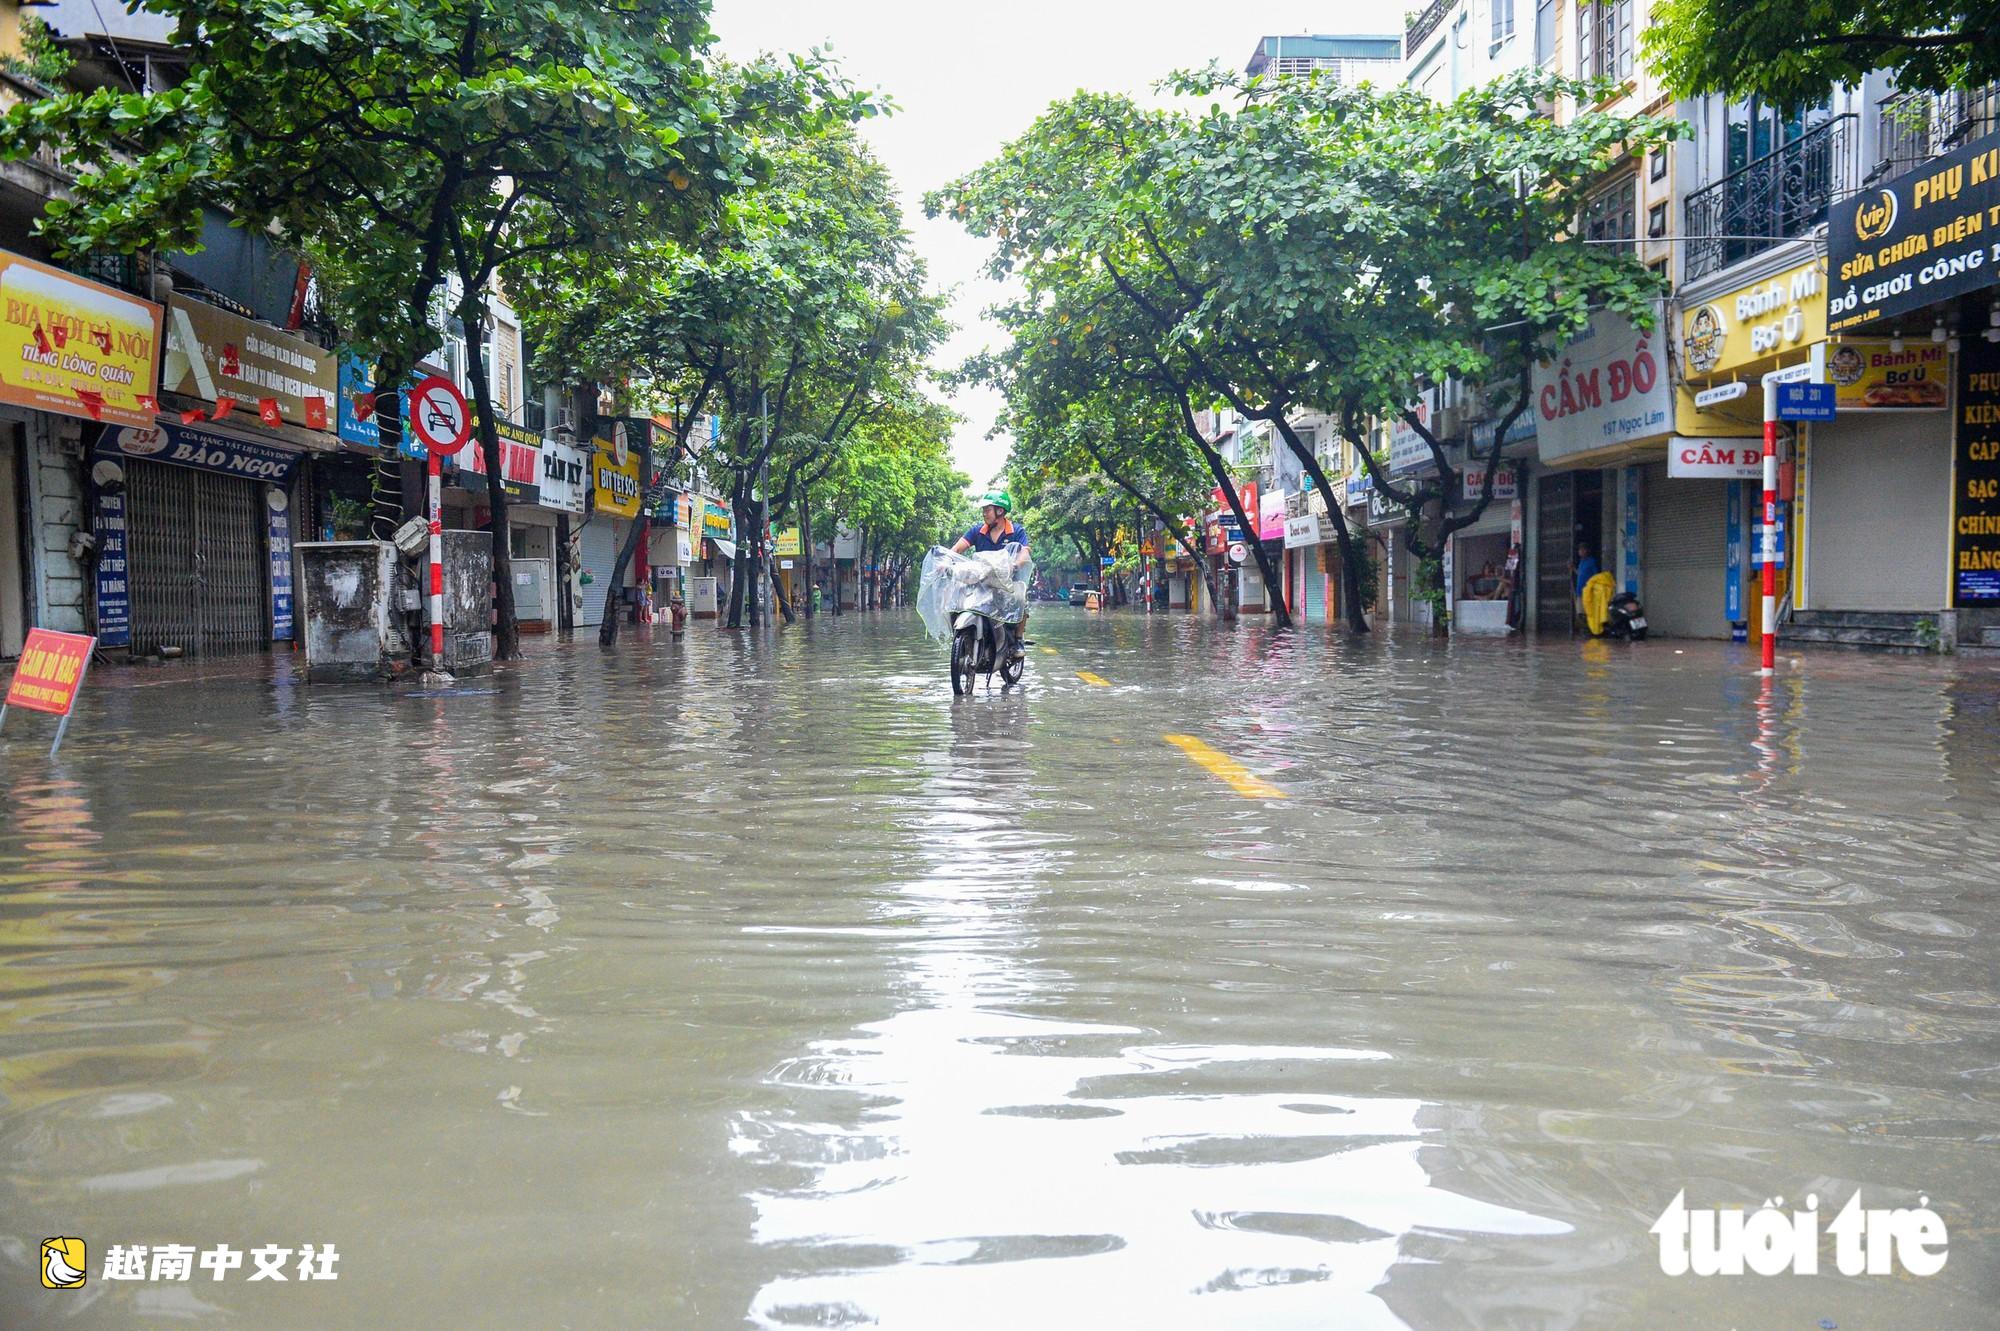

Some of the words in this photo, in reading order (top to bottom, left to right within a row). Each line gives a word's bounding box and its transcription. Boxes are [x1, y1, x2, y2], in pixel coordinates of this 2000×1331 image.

[1913, 164, 1963, 210] PHỤ
[1971, 148, 2000, 186] KI
[1840, 252, 1875, 281] SỬA
[1878, 234, 1928, 267] CHỮA
[1932, 212, 1983, 248] ĐIỆN
[1830, 284, 1858, 315] ĐỒ
[1862, 273, 1913, 304] CHƠI
[1919, 249, 1984, 285] CÔNG
[1736, 281, 1787, 320] Bánh
[117, 330, 150, 364] NỘI
[1751, 321, 1784, 353] Bơ
[62, 352, 97, 377] LÒNG
[100, 363, 134, 385] QUÁN
[1871, 350, 1916, 367] Bánh
[1540, 358, 1602, 421] CẦM
[1607, 329, 1657, 403] ĐỒ
[1886, 370, 1910, 384] Bơ
[1809, 389, 1821, 401] 201
[180, 431, 198, 441] CỬA
[200, 434, 224, 447] HÀNG
[512, 429, 525, 441] ANH
[1604, 420, 1616, 436] 197
[1619, 416, 1643, 435] Ngọc
[1644, 411, 1665, 427] Lâm
[171, 442, 225, 467] BẢO
[227, 454, 288, 479] NGỌC
[1681, 441, 1735, 465] CẦM
[1742, 450, 1764, 465] Đ
[1969, 435, 1999, 461] CÁP
[543, 450, 566, 481] TÂN
[567, 458, 583, 485] KỲ
[1968, 479, 1998, 502] SẠC
[20, 641, 47, 678] CẤM
[54, 650, 80, 685] RÁC
